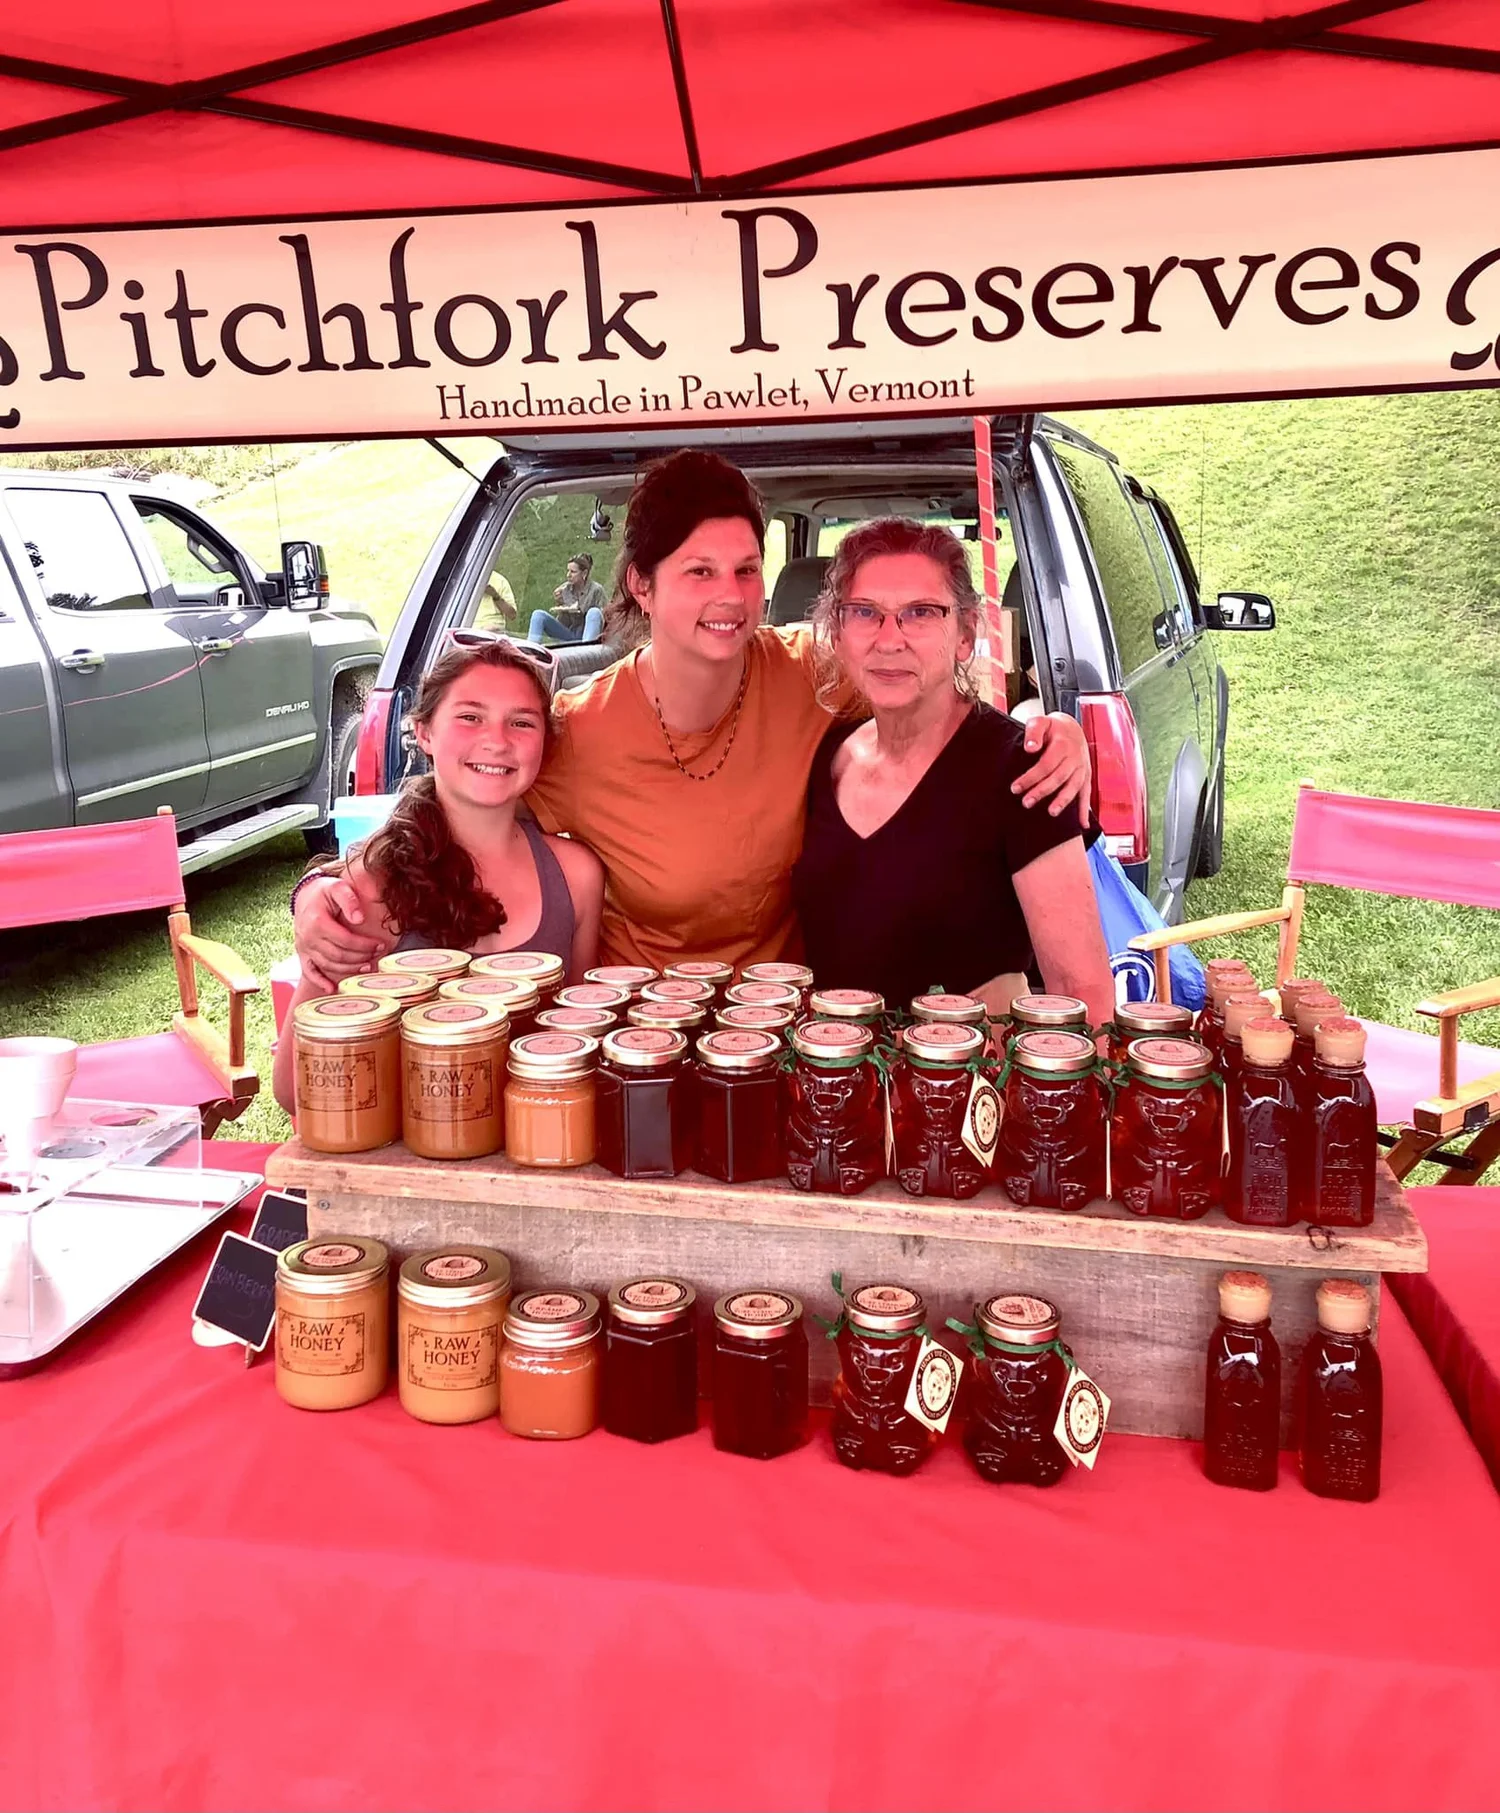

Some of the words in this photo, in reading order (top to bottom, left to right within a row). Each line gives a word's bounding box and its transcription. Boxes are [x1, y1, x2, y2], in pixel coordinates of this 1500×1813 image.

[14, 219, 668, 382] Pitchfork
[721, 205, 1422, 354] Preserves
[436, 379, 632, 420] Handmade
[639, 387, 673, 412] in
[678, 372, 809, 411] Pawlet,
[815, 367, 976, 404] Vermont
[265, 703, 297, 717] DENALI
[297, 700, 310, 711] HD
[312, 1059, 346, 1073] RAW
[305, 1073, 357, 1088] HONEY
[430, 1069, 464, 1084] RAW
[421, 1083, 475, 1098] HONEY
[299, 1321, 335, 1336] RAW
[290, 1333, 345, 1351] HONEY
[434, 1336, 471, 1351] RAW
[424, 1349, 481, 1366] HONEY
